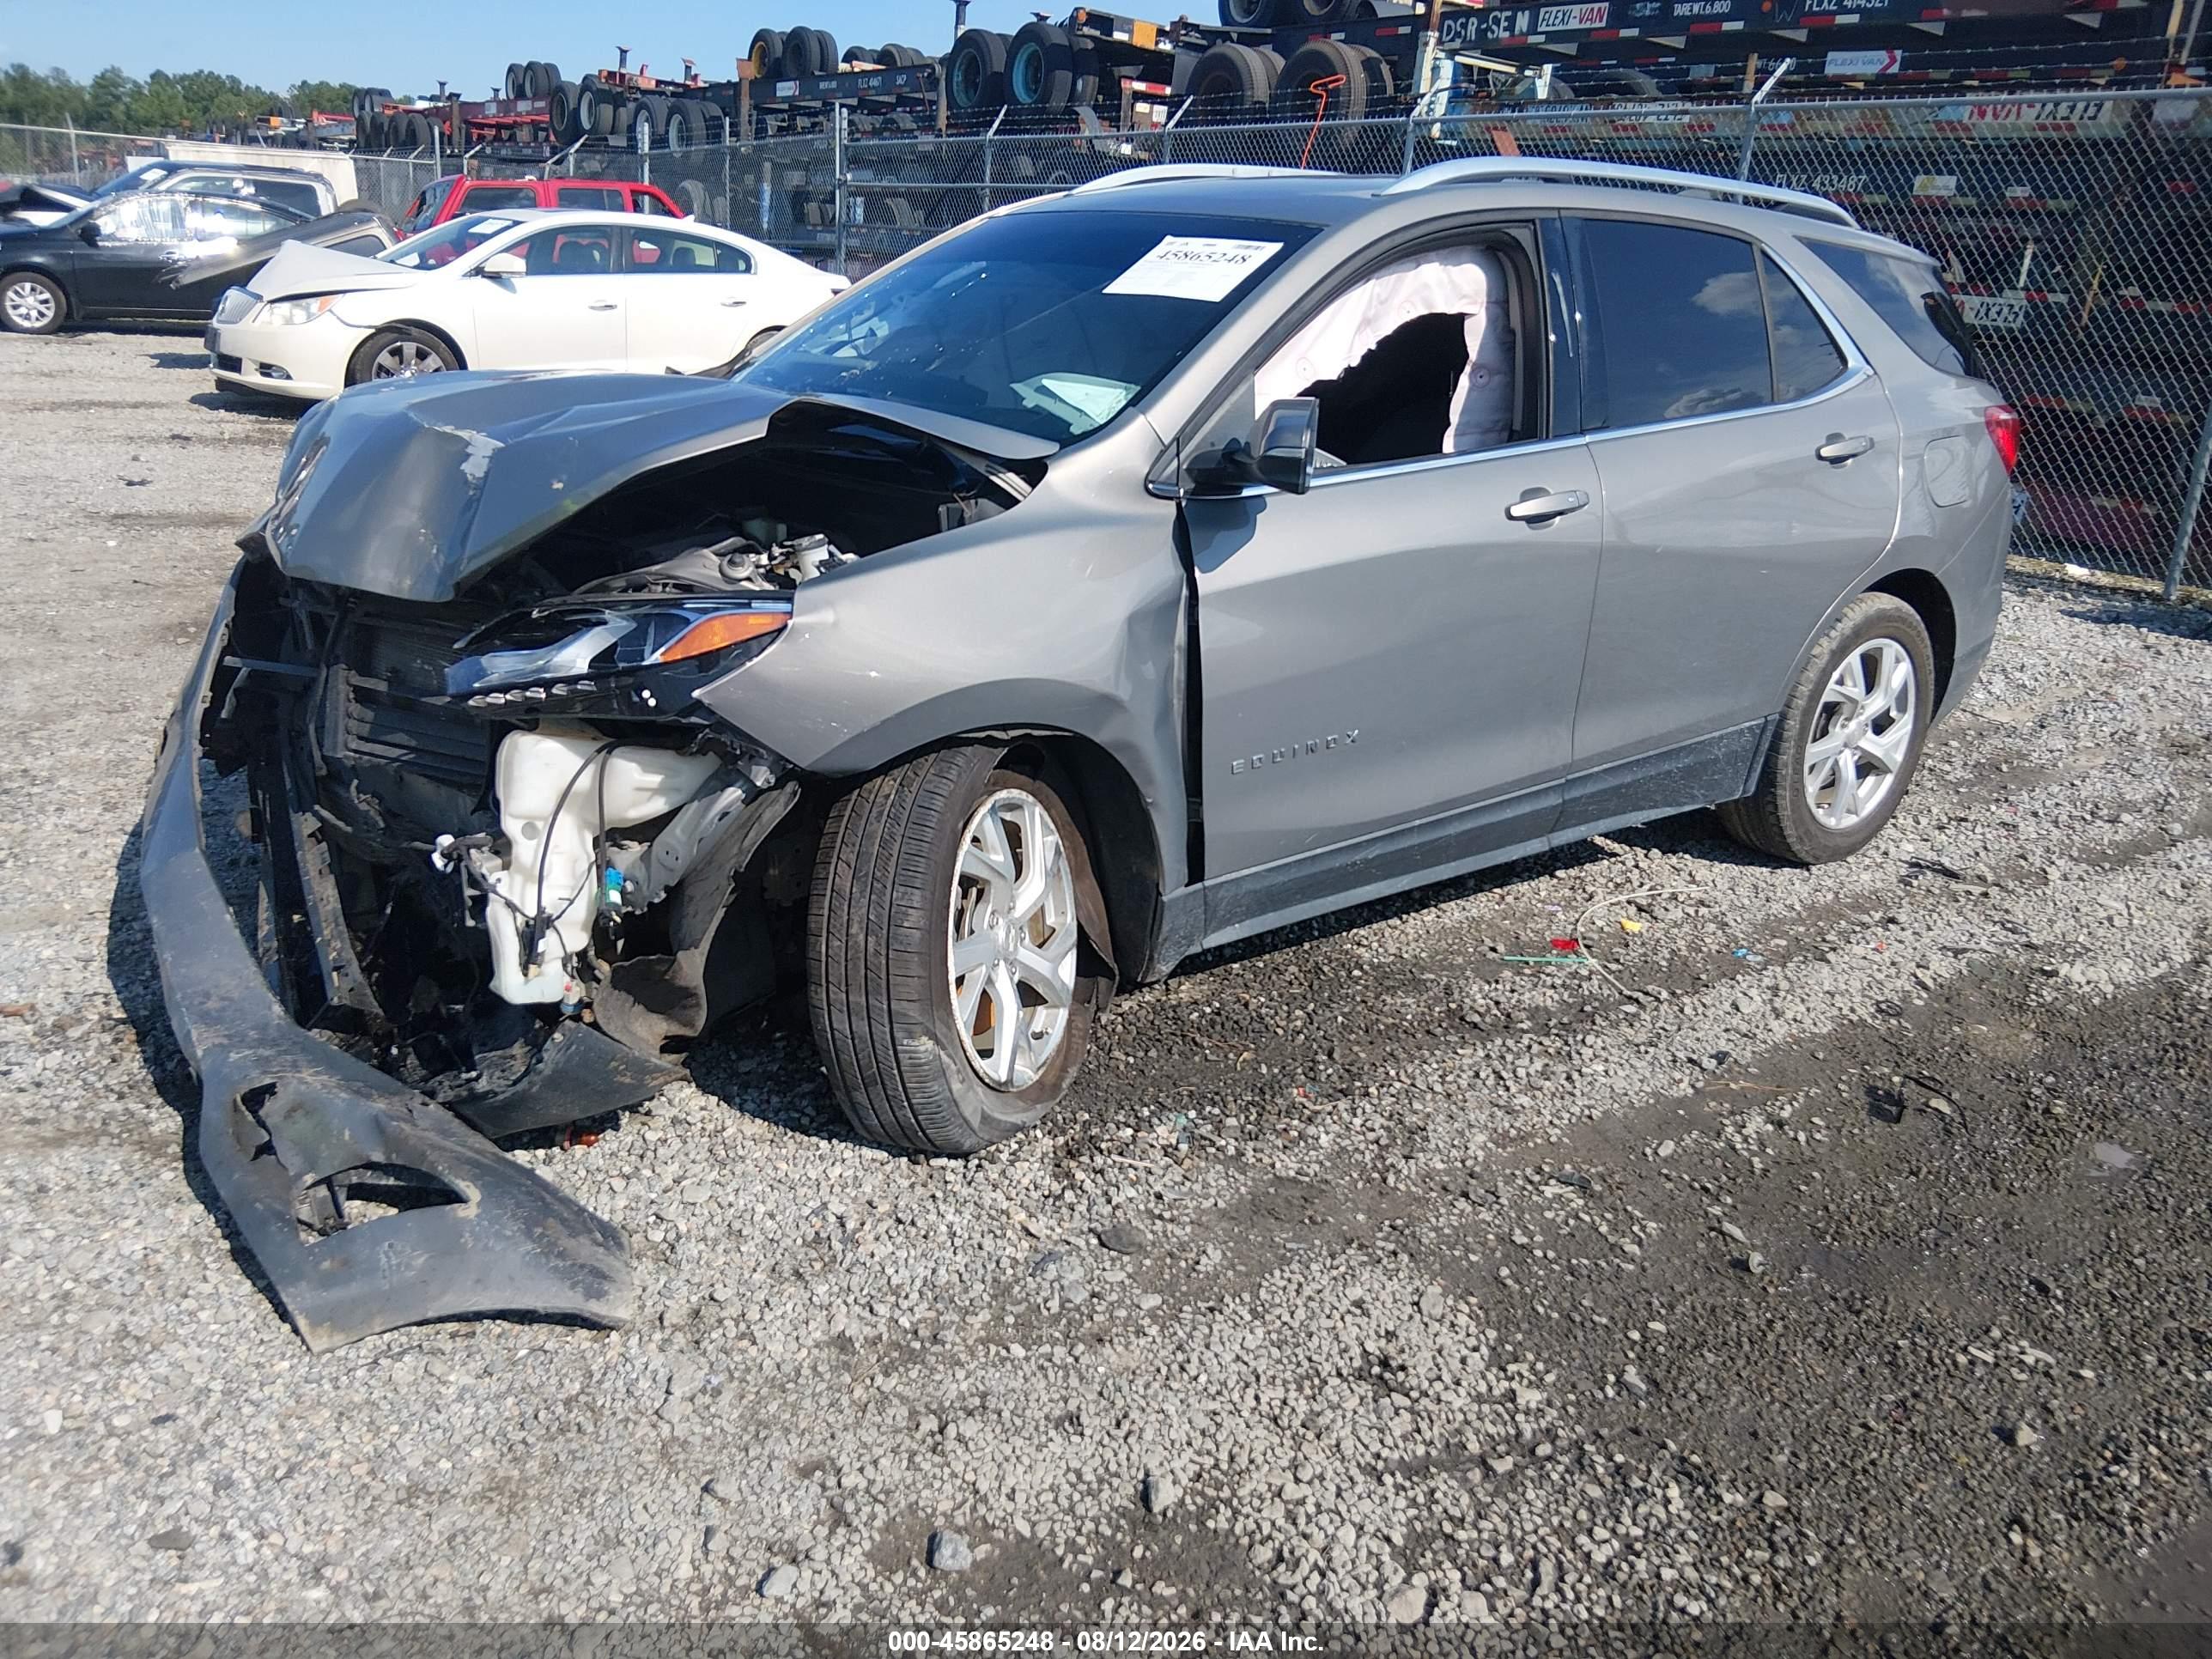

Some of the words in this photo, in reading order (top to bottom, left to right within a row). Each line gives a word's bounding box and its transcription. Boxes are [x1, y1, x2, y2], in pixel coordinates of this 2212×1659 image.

[1540, 7, 1607, 27] FLEXI-VAN
[1156, 248, 1253, 265] 45865248
[1231, 730, 1359, 775] EQUINOX
